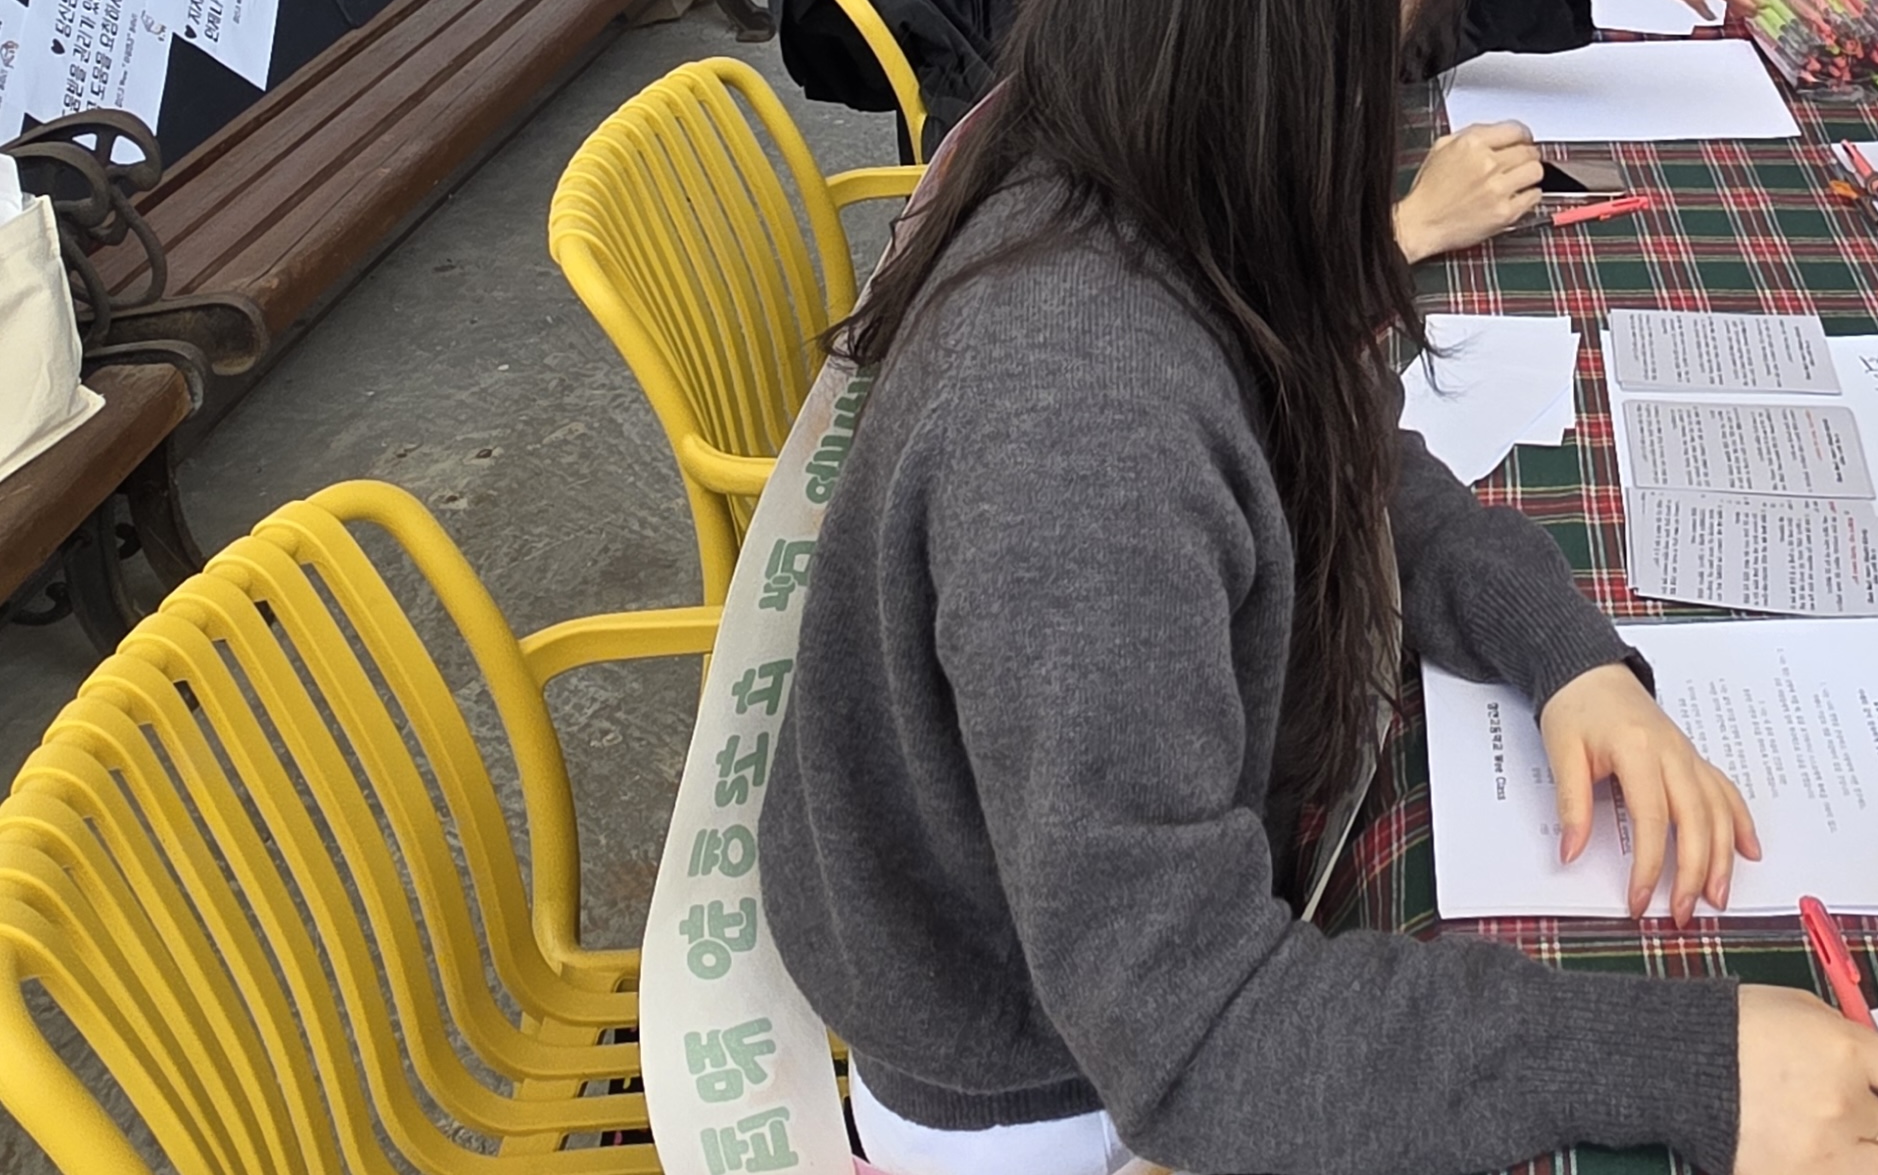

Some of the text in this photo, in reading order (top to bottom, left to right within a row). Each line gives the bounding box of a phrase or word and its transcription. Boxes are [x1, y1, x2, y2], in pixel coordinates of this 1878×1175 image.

[72, 15, 96, 64] 권리가
[61, 63, 88, 115] 움받을
[90, 51, 113, 101] 도움을
